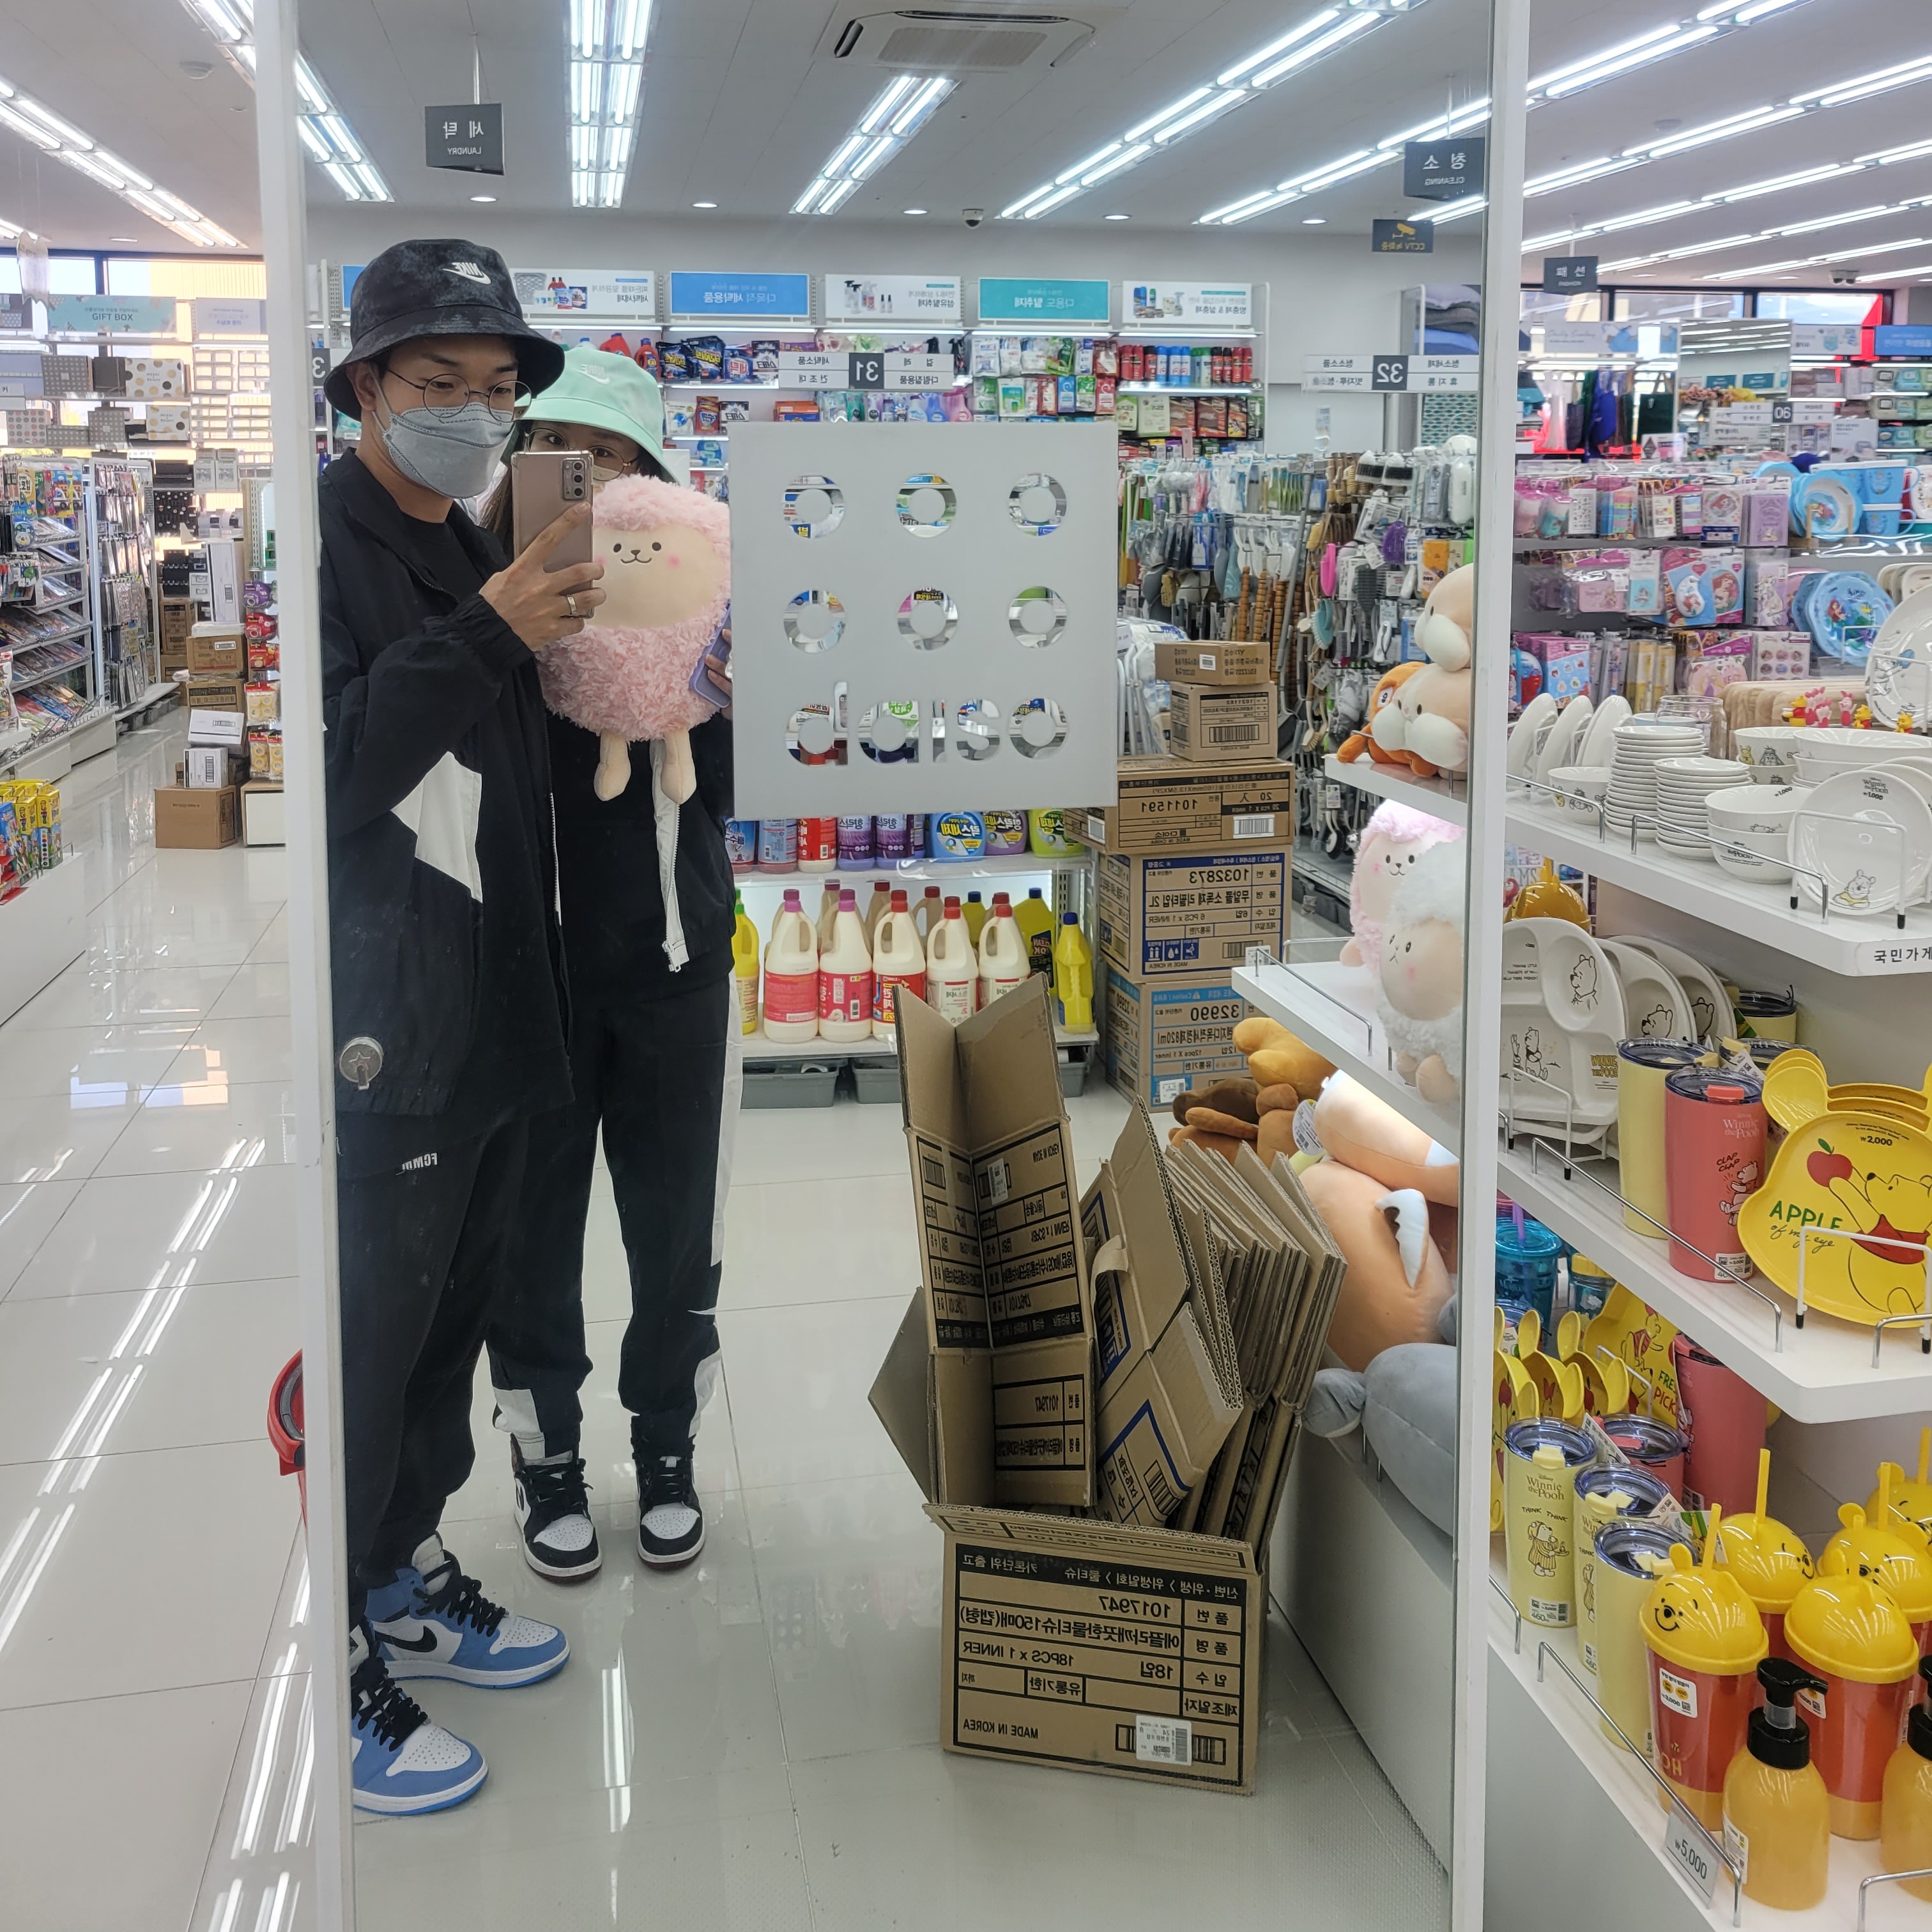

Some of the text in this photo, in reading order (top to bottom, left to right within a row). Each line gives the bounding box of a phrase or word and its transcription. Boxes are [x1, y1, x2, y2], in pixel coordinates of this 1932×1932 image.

[92, 313, 134, 321] GIFT BOX
[1774, 406, 1791, 419] 06
[784, 681, 1068, 766] daiso
[1591, 1054, 1618, 1068] WINNIE
[1722, 1118, 1758, 1131] Winnie
[1735, 1128, 1759, 1139] Pooh
[1716, 1151, 1738, 1165] CLAP
[1718, 1158, 1740, 1172] CLAP
[1769, 1200, 1844, 1230] APPLE
[1770, 1223, 1789, 1240] of
[1813, 1234, 1836, 1254] eye
[1526, 1475, 1563, 1492] Winnie
[1528, 1486, 1565, 1501] the Pooh
[1545, 1510, 1569, 1522] THINK
[1579, 1546, 1595, 1558] THINK
[1674, 1837, 1708, 1880] ₩5,000
